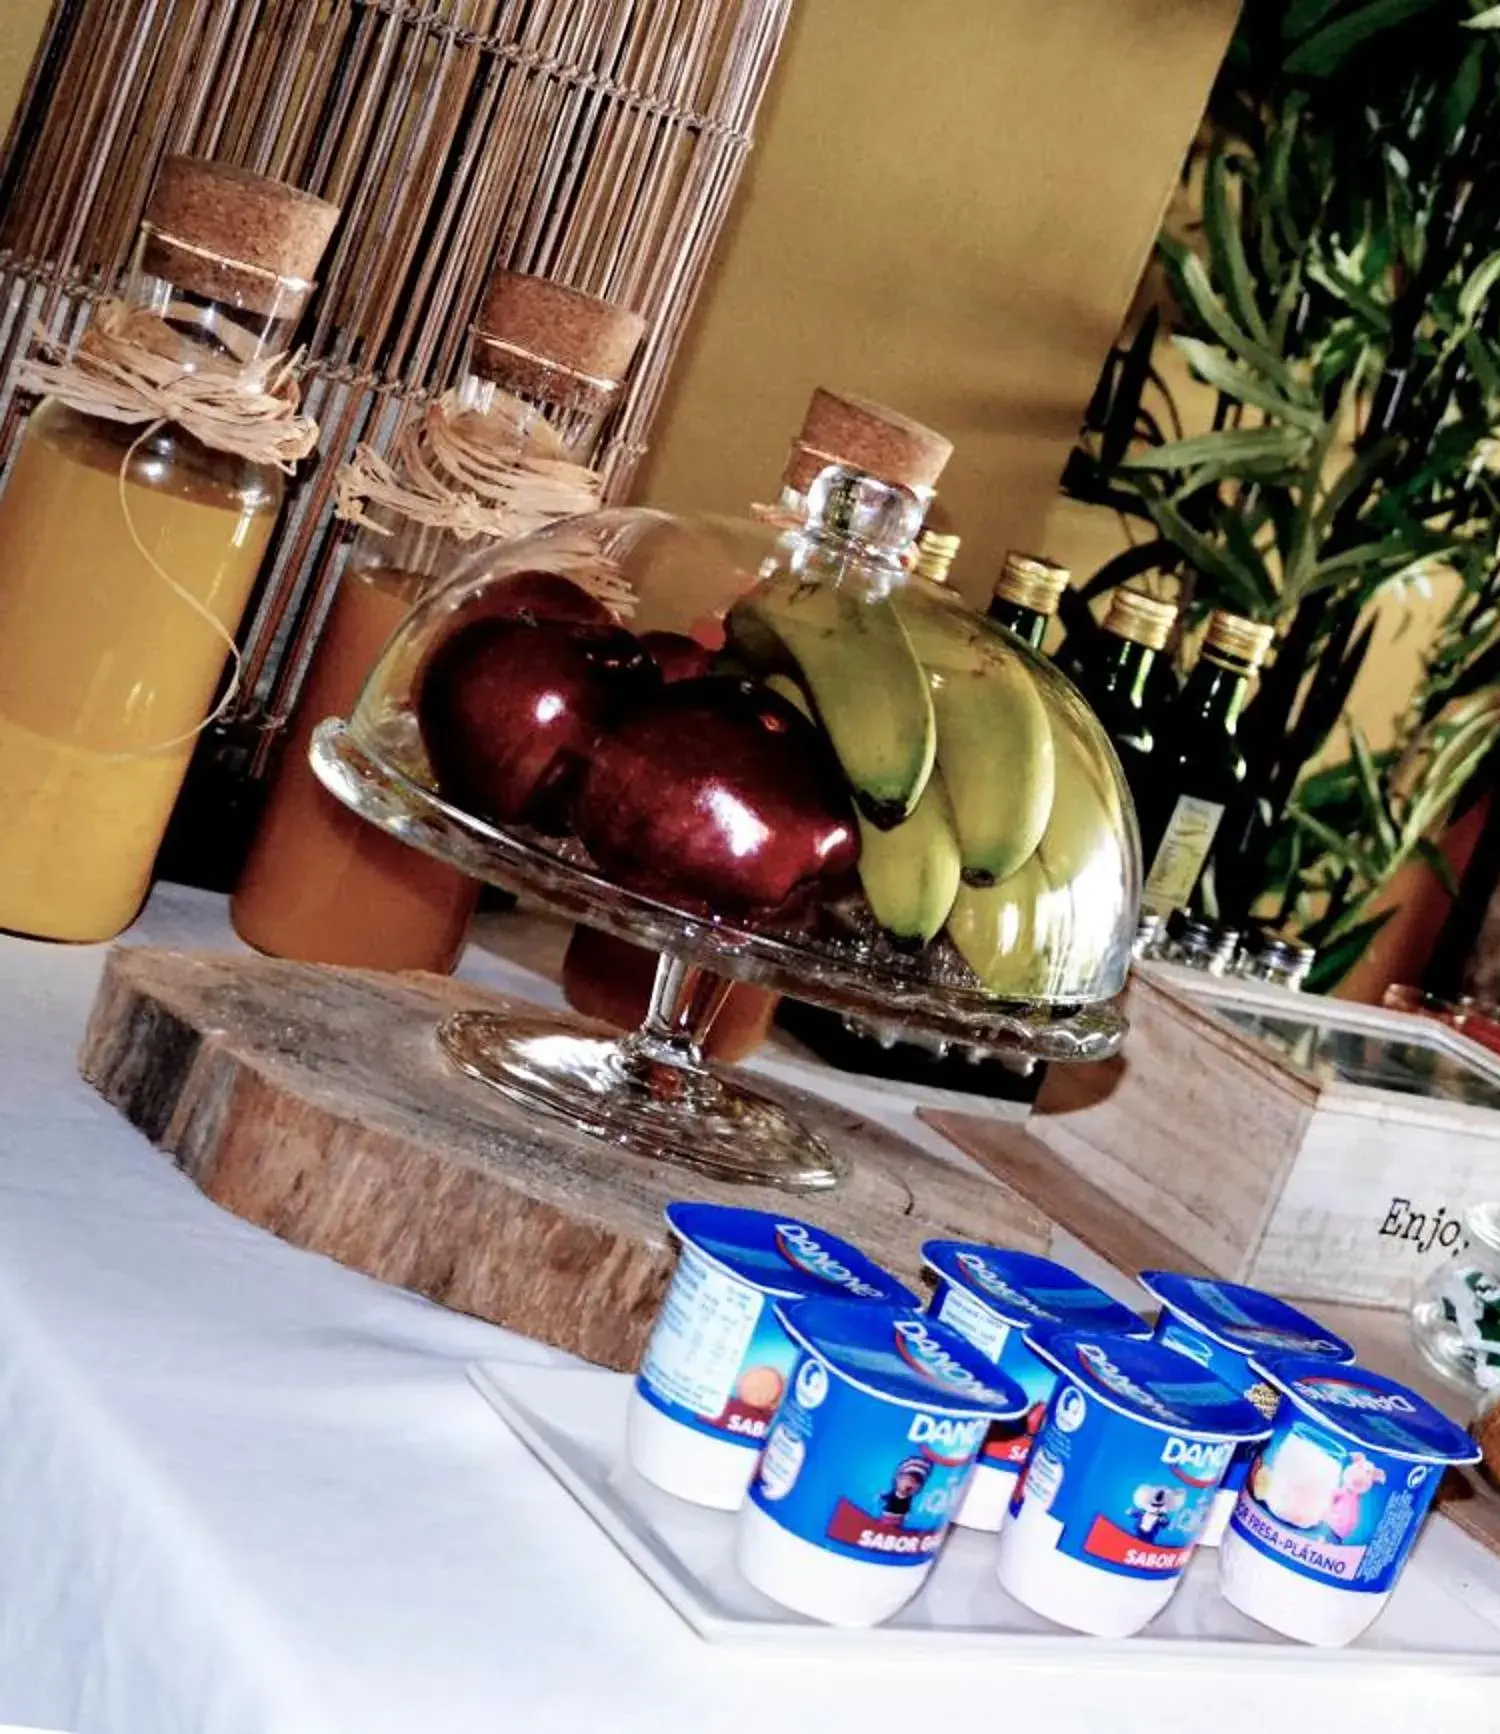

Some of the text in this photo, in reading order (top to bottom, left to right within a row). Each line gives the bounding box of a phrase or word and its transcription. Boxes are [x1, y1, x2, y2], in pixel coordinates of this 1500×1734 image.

[1378, 1197, 1470, 1257] Enjo
[774, 1224, 885, 1299] DANONE
[857, 1529, 920, 1552] SABOR
[1123, 1548, 1176, 1569] SABOR
